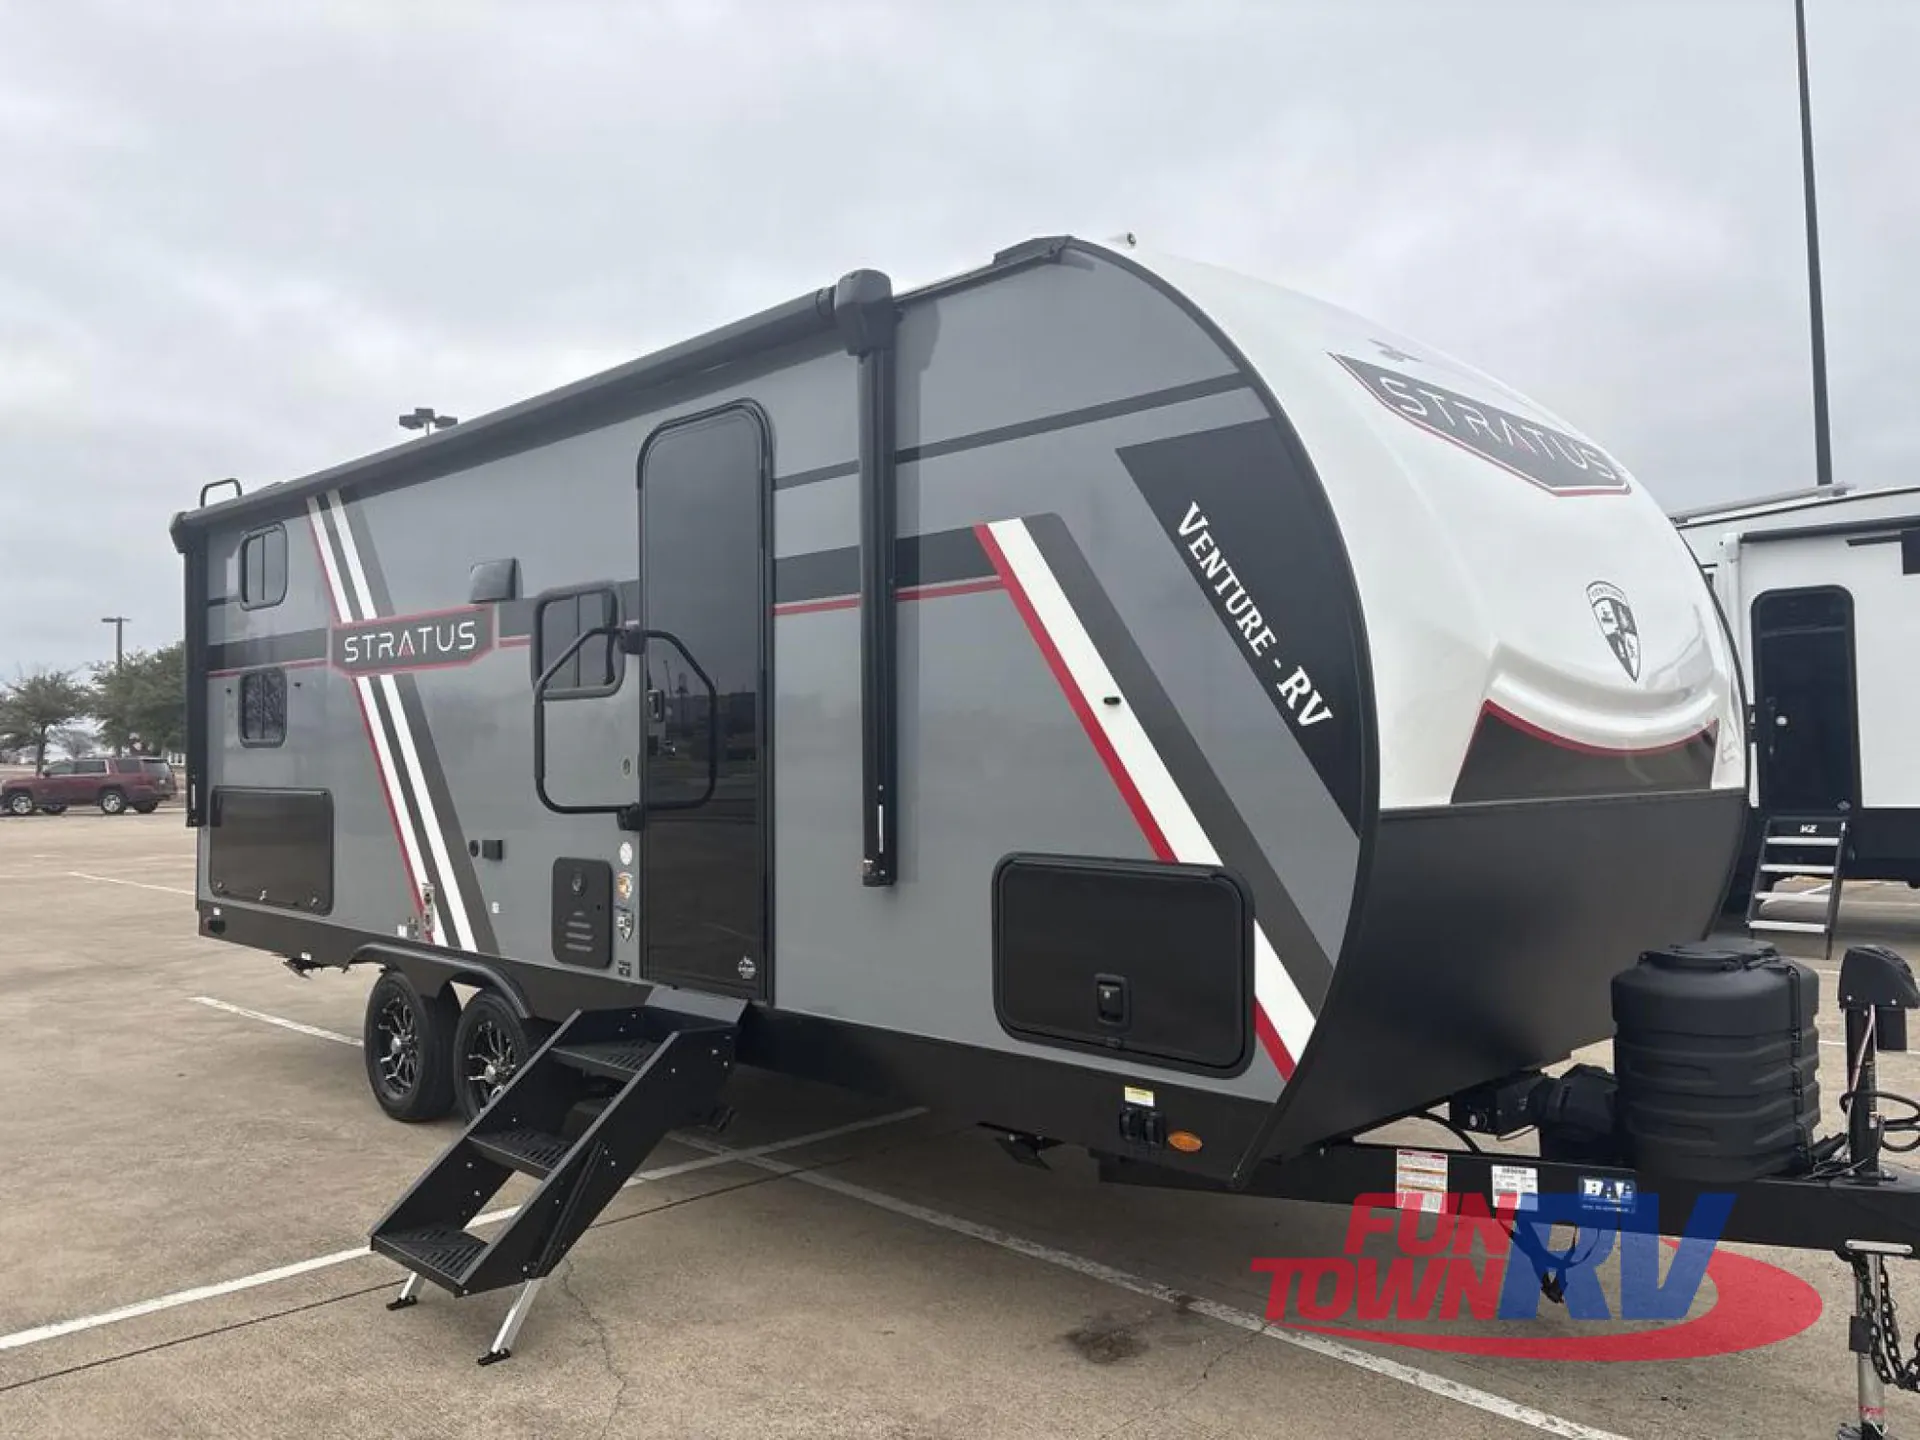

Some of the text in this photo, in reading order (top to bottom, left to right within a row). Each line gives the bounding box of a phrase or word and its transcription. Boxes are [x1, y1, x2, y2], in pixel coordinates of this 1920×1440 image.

[1379, 376, 1617, 481] STRATUS
[344, 620, 477, 663] STRATUS
[1276, 665, 1334, 727] RV
